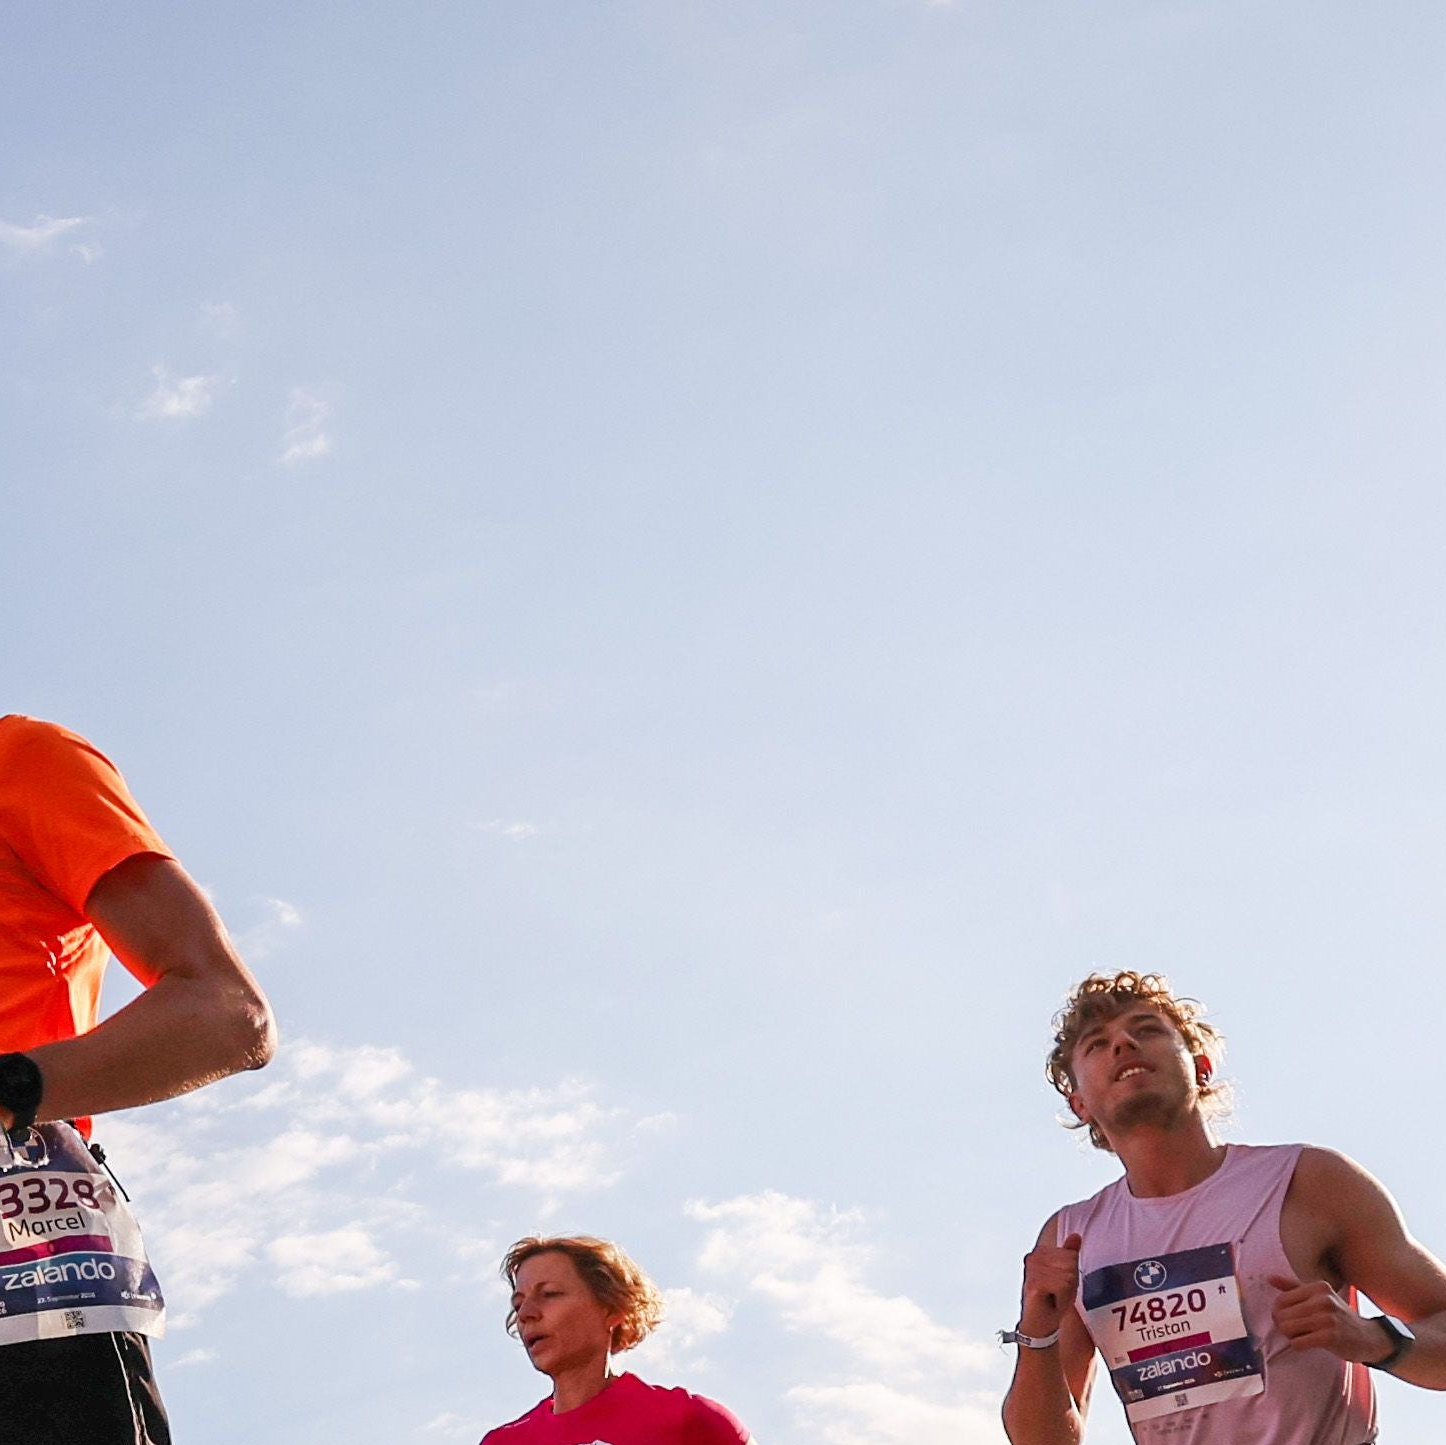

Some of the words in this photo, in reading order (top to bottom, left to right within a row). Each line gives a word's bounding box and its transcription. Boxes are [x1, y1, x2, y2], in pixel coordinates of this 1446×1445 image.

[8, 1212, 86, 1242] Marcel
[2, 1258, 116, 1291] zalando
[1111, 1288, 1207, 1332] 74820
[1136, 1319, 1191, 1343] Tristan
[1137, 1351, 1211, 1382] zalando
